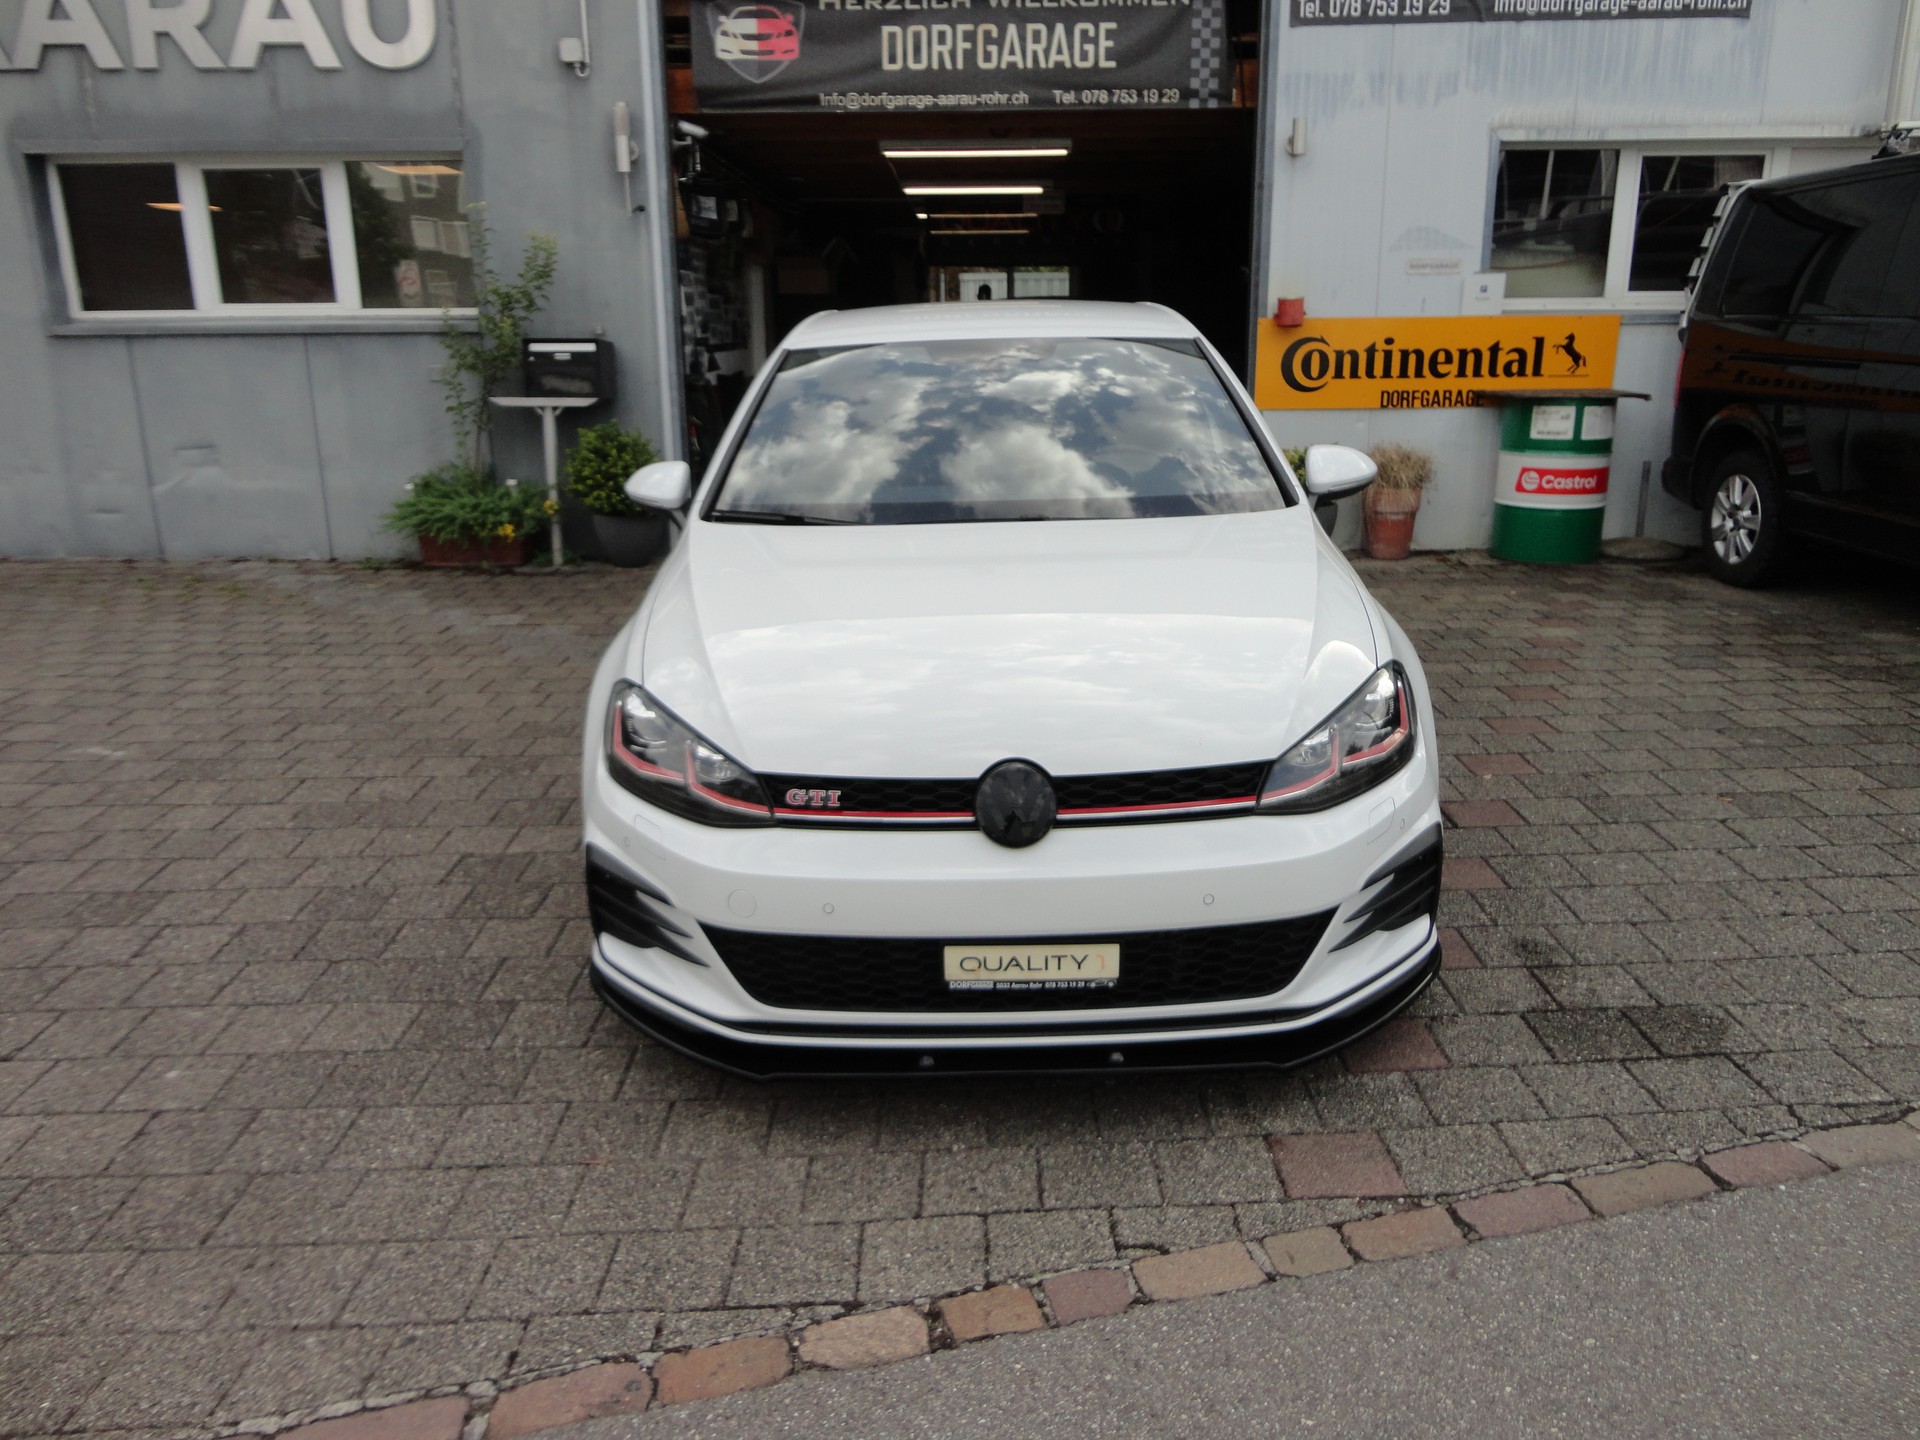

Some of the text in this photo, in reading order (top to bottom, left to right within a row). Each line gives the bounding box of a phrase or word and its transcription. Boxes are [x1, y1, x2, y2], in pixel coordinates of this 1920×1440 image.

[1297, 0, 1450, 18] Tel. 078 753 19 29
[0, 0, 437, 70] ARAU
[881, 22, 1118, 70] DORFGARAGE
[818, 88, 1180, 109] Info@dorfgarage-aarau-rohr.ch Tel. 078 753 19 29
[1280, 335, 1546, 393] Continental
[1541, 474, 1597, 490] Castrol
[785, 789, 841, 807] GTI
[959, 954, 1089, 973] QUALITY
